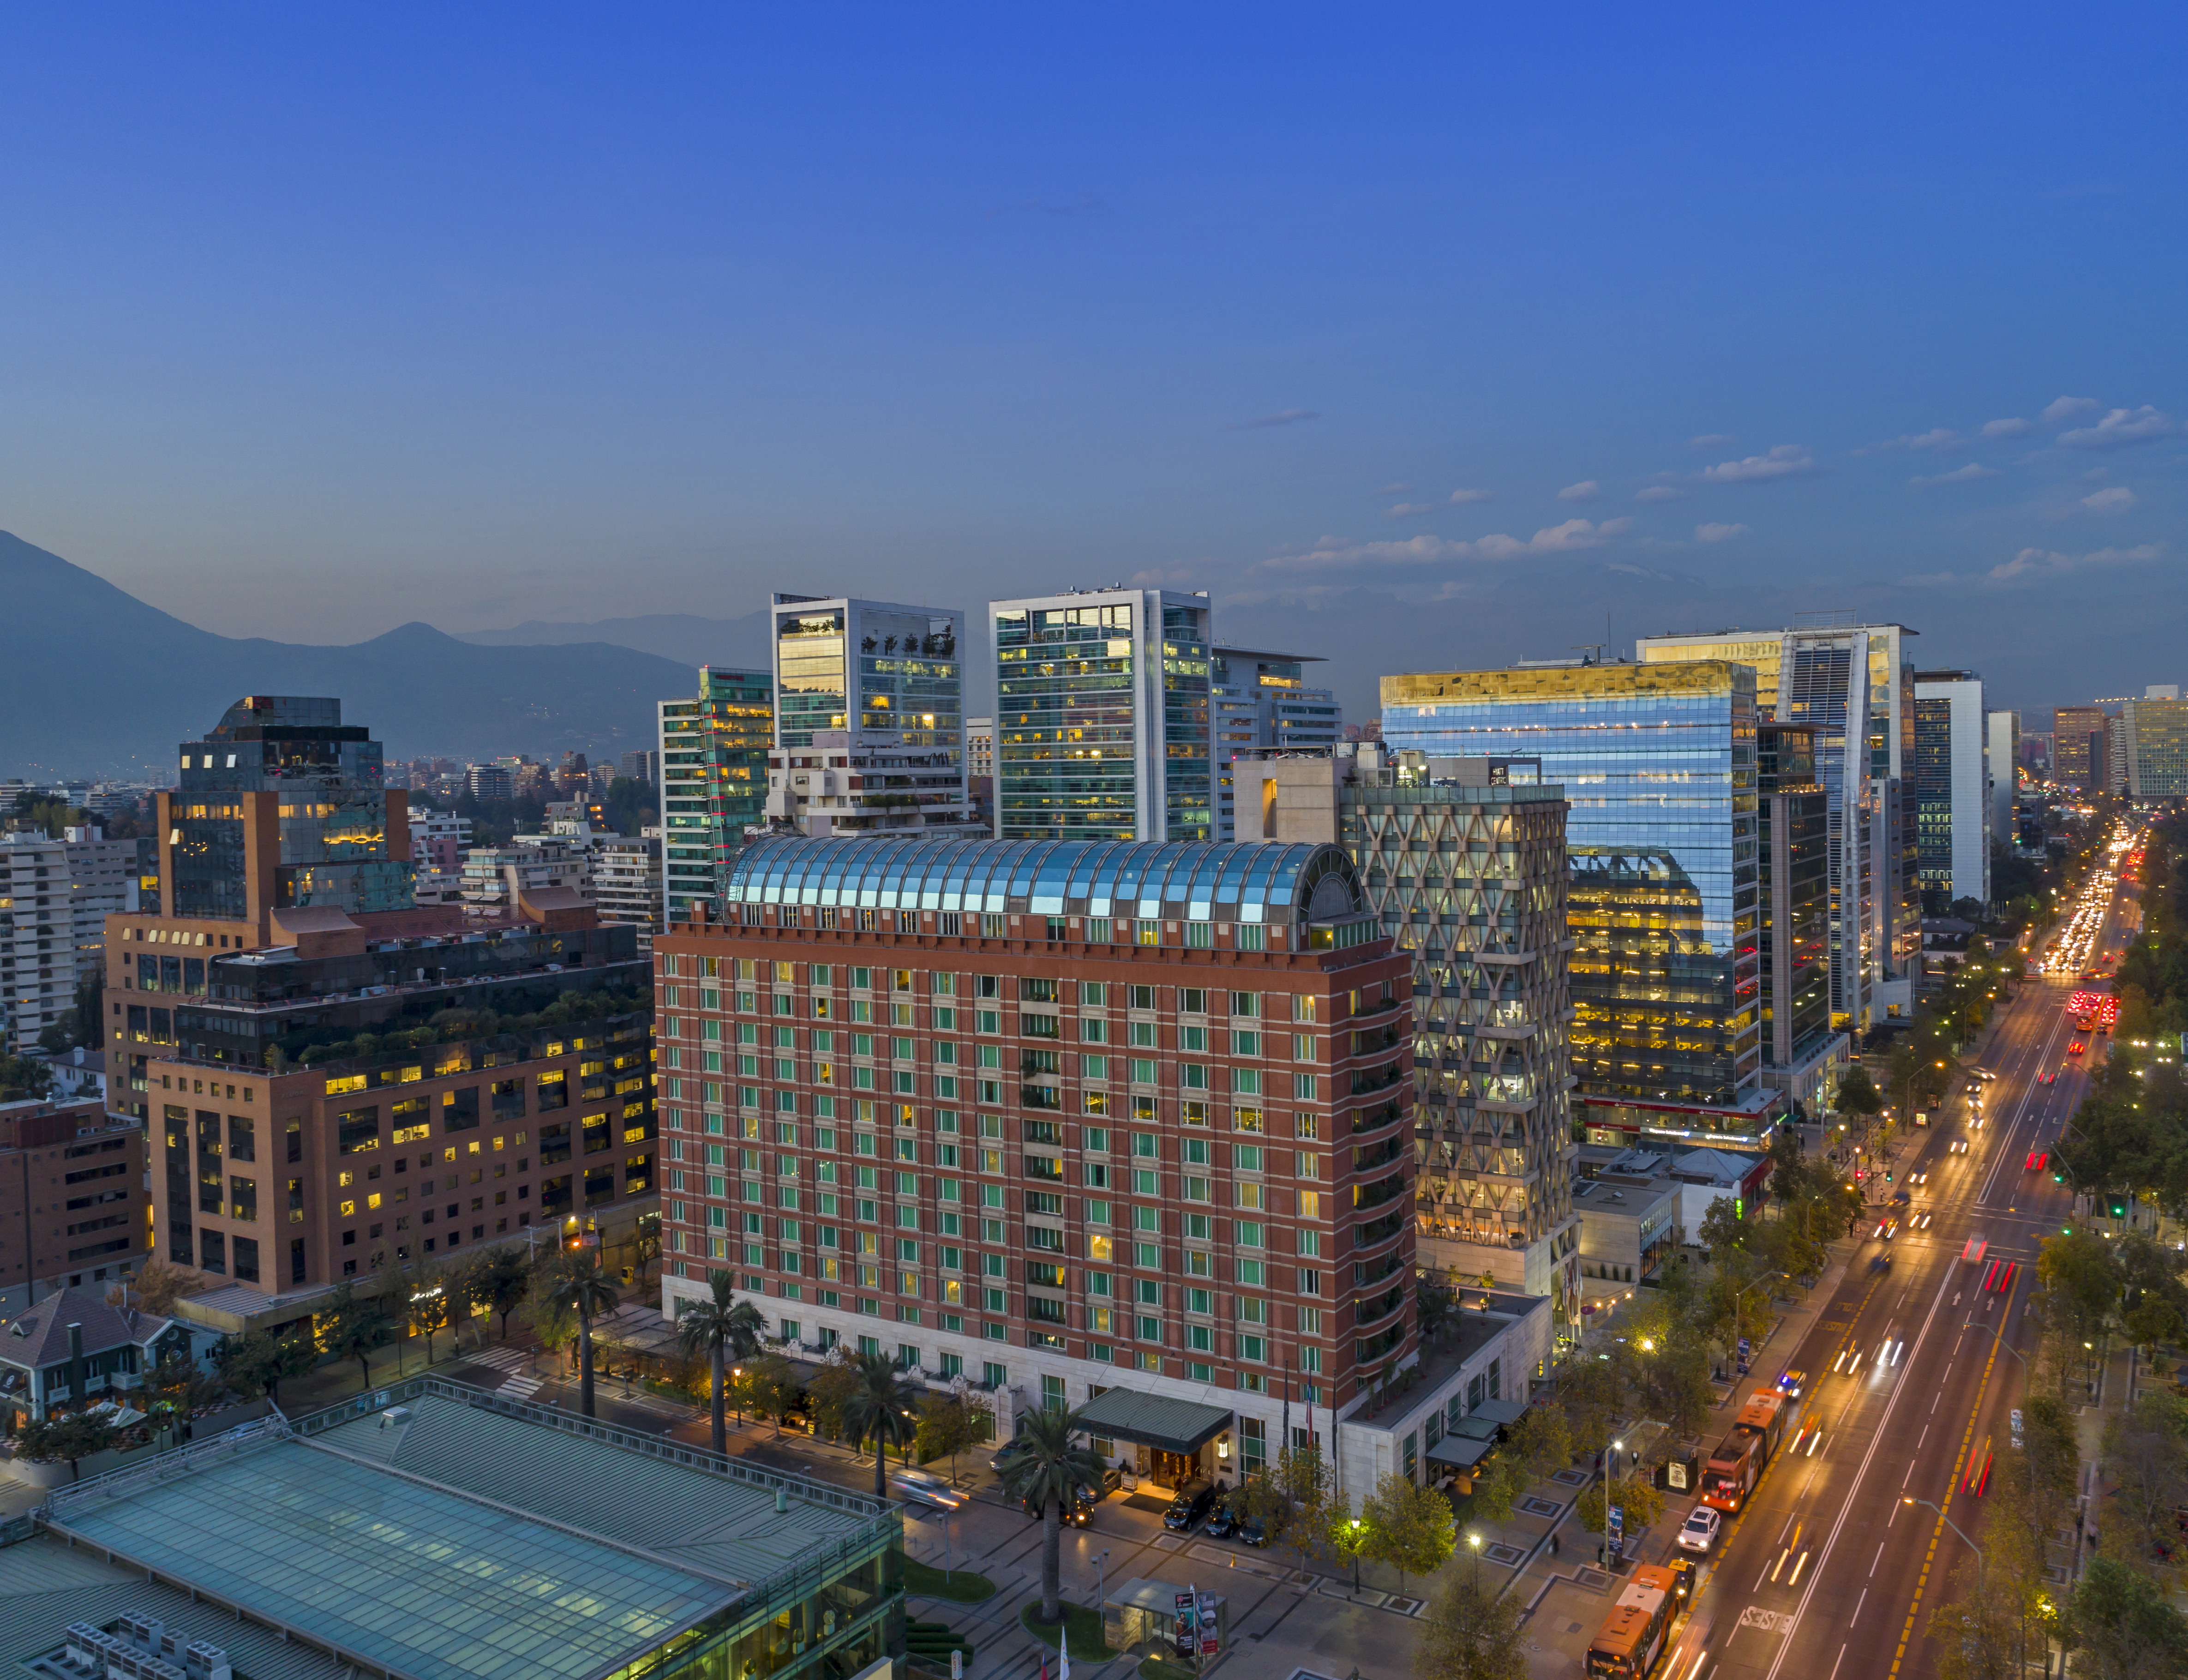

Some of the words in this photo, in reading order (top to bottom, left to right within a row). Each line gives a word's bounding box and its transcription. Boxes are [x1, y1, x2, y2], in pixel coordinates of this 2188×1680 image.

[1493, 768, 1504, 776] HYATT
[1491, 777, 1506, 786] CENTRIC
[1091, 1423, 1104, 1434] THE
[1741, 1606, 1794, 1634] BUSES
